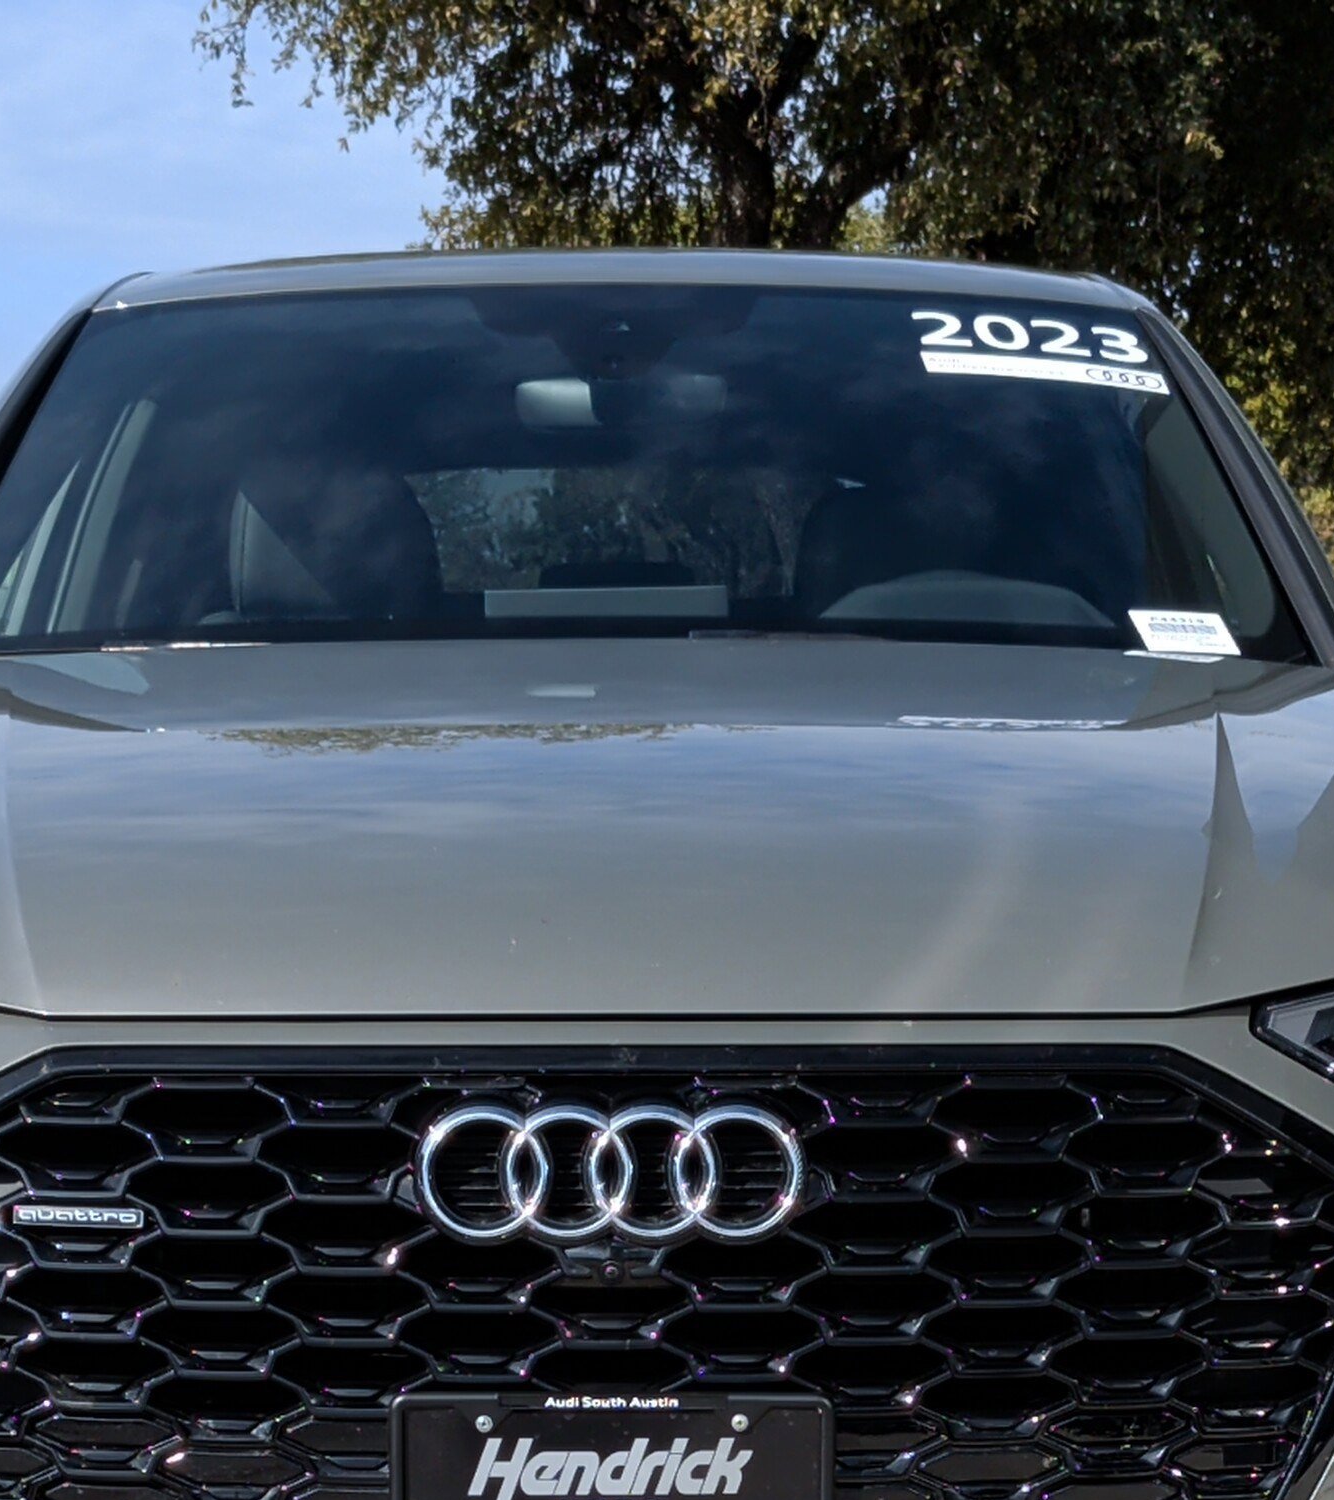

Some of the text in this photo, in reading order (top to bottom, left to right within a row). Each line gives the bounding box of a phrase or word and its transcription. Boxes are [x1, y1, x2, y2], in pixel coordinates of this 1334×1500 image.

[911, 311, 1149, 363] 2023
[18, 1208, 138, 1223] quattro
[544, 1396, 680, 1409] Audi South Austin
